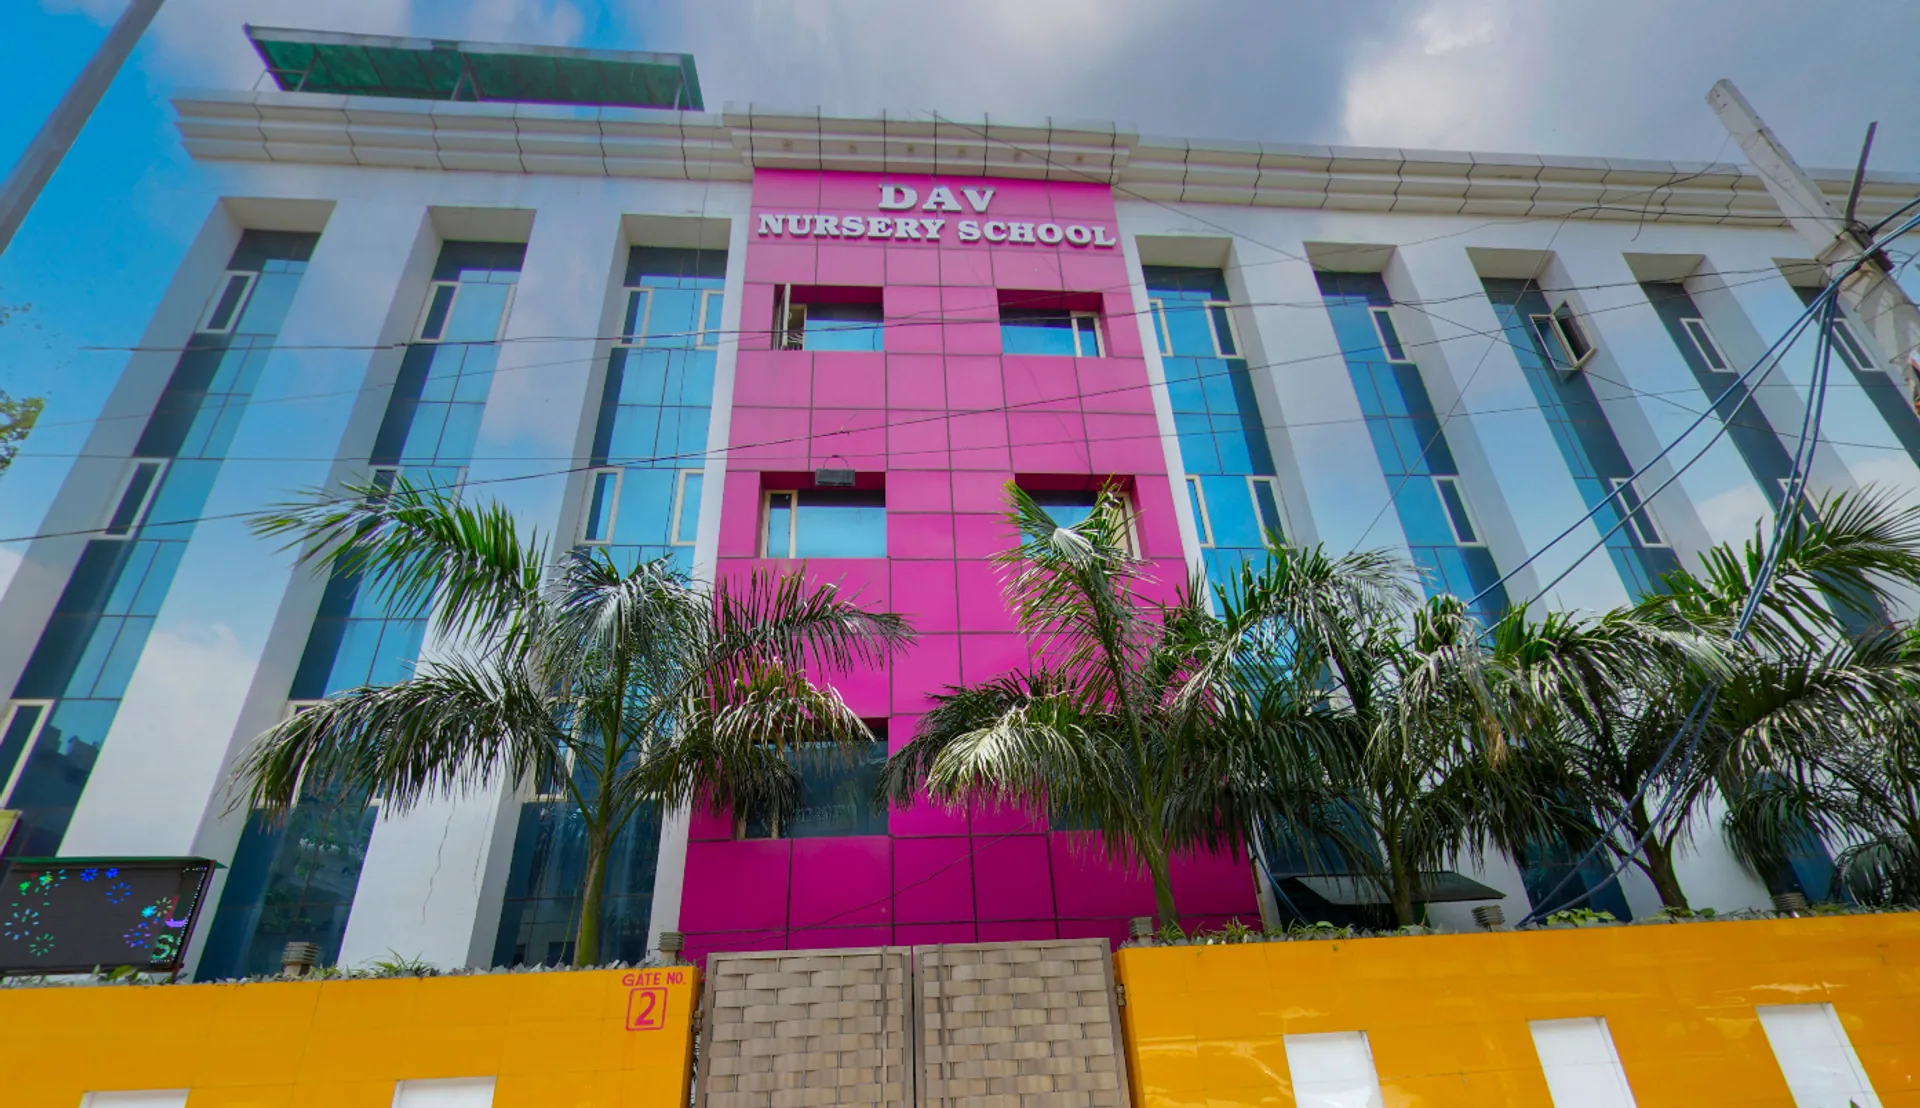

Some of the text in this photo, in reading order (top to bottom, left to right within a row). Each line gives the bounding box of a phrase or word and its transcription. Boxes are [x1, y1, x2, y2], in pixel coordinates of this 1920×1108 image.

[878, 183, 996, 213] DAV
[758, 213, 1117, 248] NURSERY SCHOOL
[621, 971, 687, 987] GATE NO.
[634, 990, 656, 1026] 2
